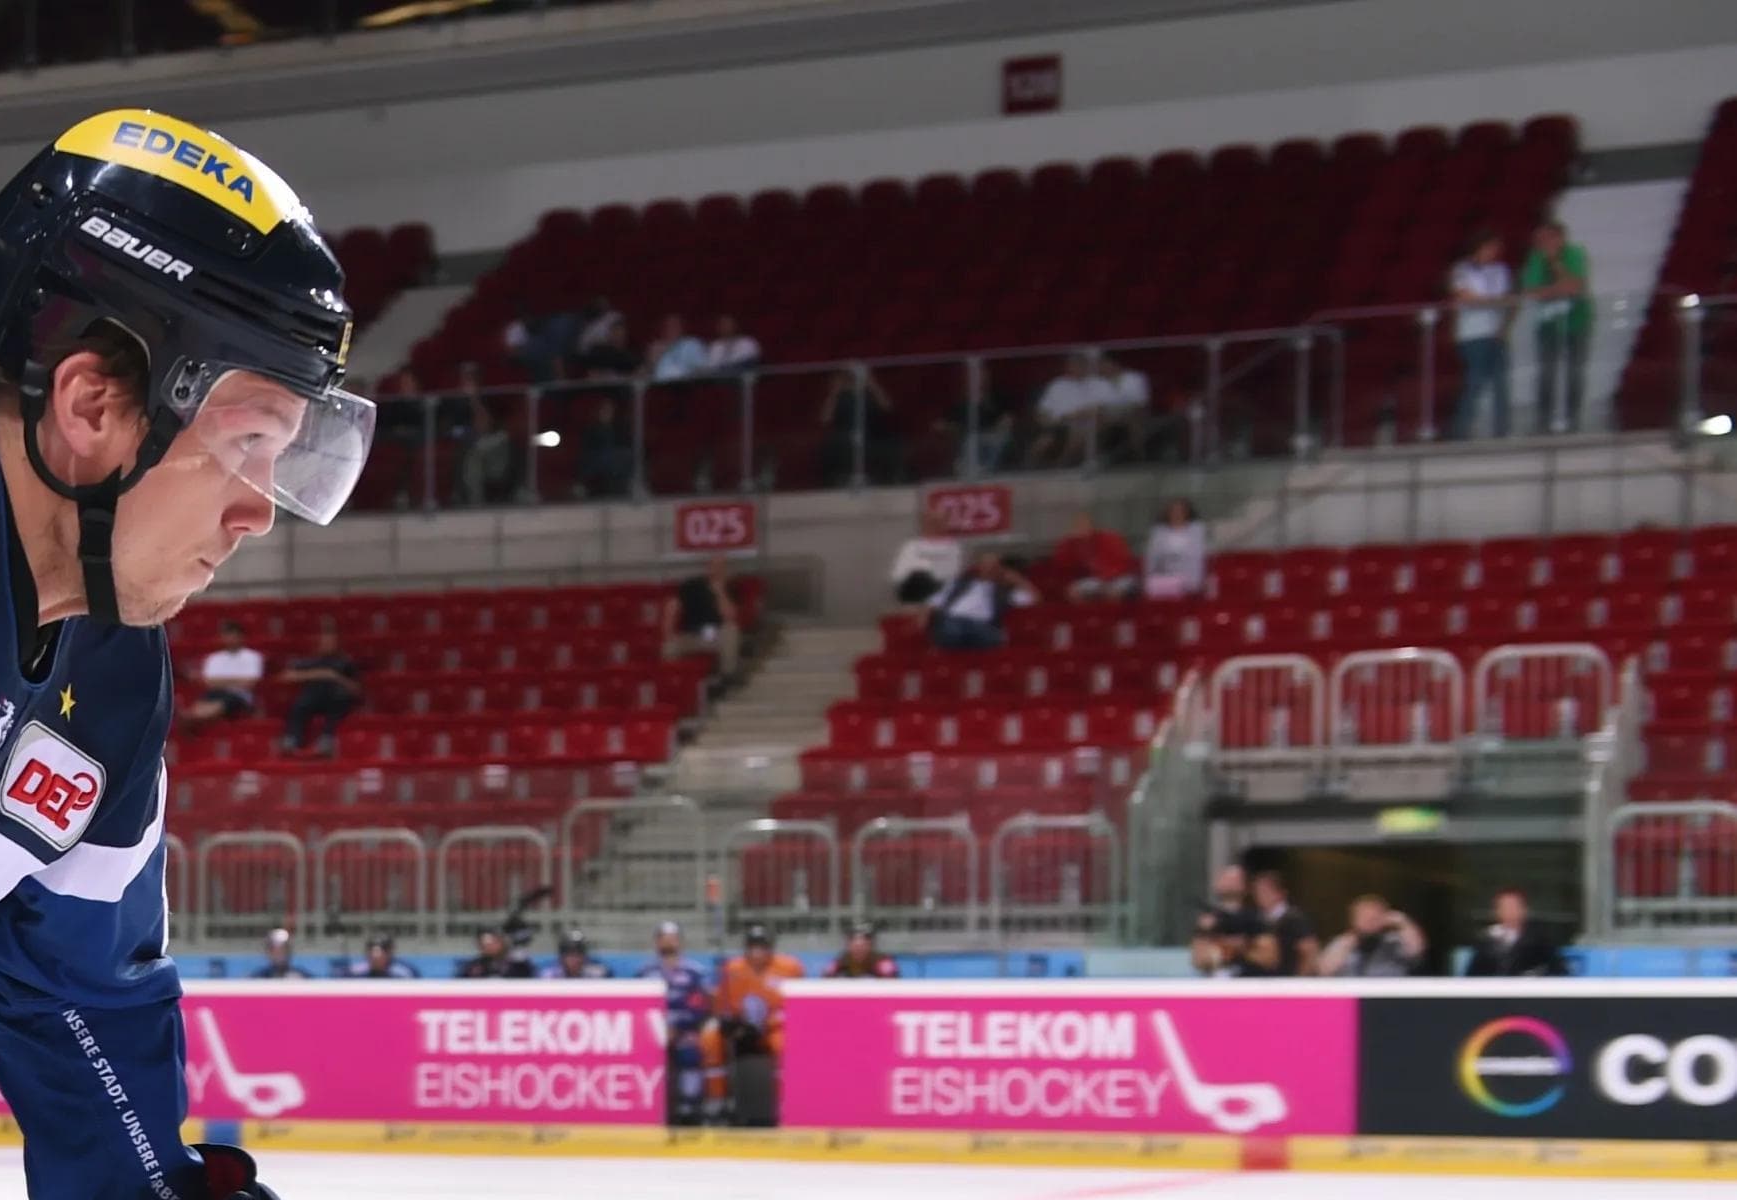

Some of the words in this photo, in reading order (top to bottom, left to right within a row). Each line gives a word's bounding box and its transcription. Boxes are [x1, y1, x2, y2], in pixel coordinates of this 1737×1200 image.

[113, 121, 254, 204] EDEKA
[417, 1009, 634, 1055] TELEKOM
[892, 1009, 1136, 1060] TELEKOM
[415, 1062, 665, 1110] EISHOCKEY
[890, 1066, 1172, 1119] EISHOCKEY
[121, 1109, 160, 1172] UNSERE
